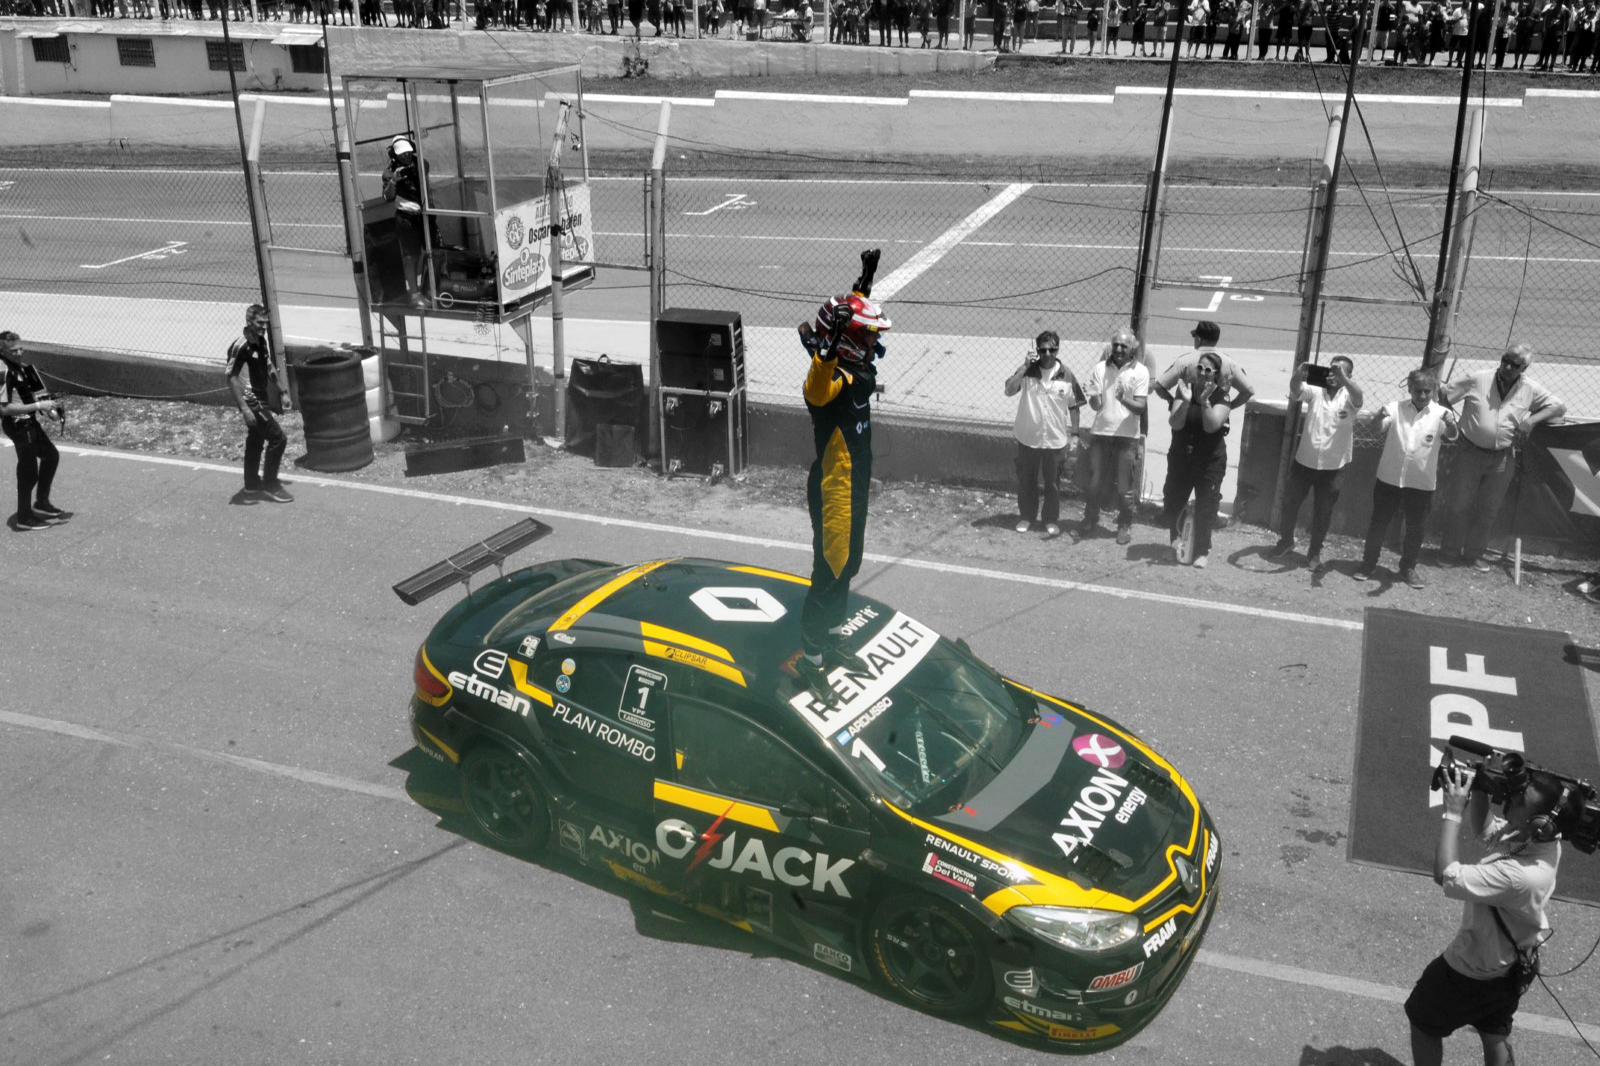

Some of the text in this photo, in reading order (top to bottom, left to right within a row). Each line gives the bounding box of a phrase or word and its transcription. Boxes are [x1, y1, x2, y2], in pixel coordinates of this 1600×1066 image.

[528, 225, 551, 244] Oscar
[561, 212, 582, 234] balén
[505, 256, 544, 287] Sinteplast
[805, 620, 924, 722] RENAULT
[447, 671, 531, 716] etman
[638, 687, 650, 709] 1
[552, 702, 656, 763] PLAN ROMBO
[848, 696, 893, 737] ARDUSSO
[851, 737, 886, 772] 1
[1052, 767, 1129, 862] AXION
[1115, 786, 1148, 824] energy
[707, 831, 856, 899] JACK
[926, 834, 981, 864] RENAULT
[934, 864, 976, 888] Del Valle
[937, 859, 977, 881] CONSTRUCTORA
[1143, 917, 1178, 958] FRAM
